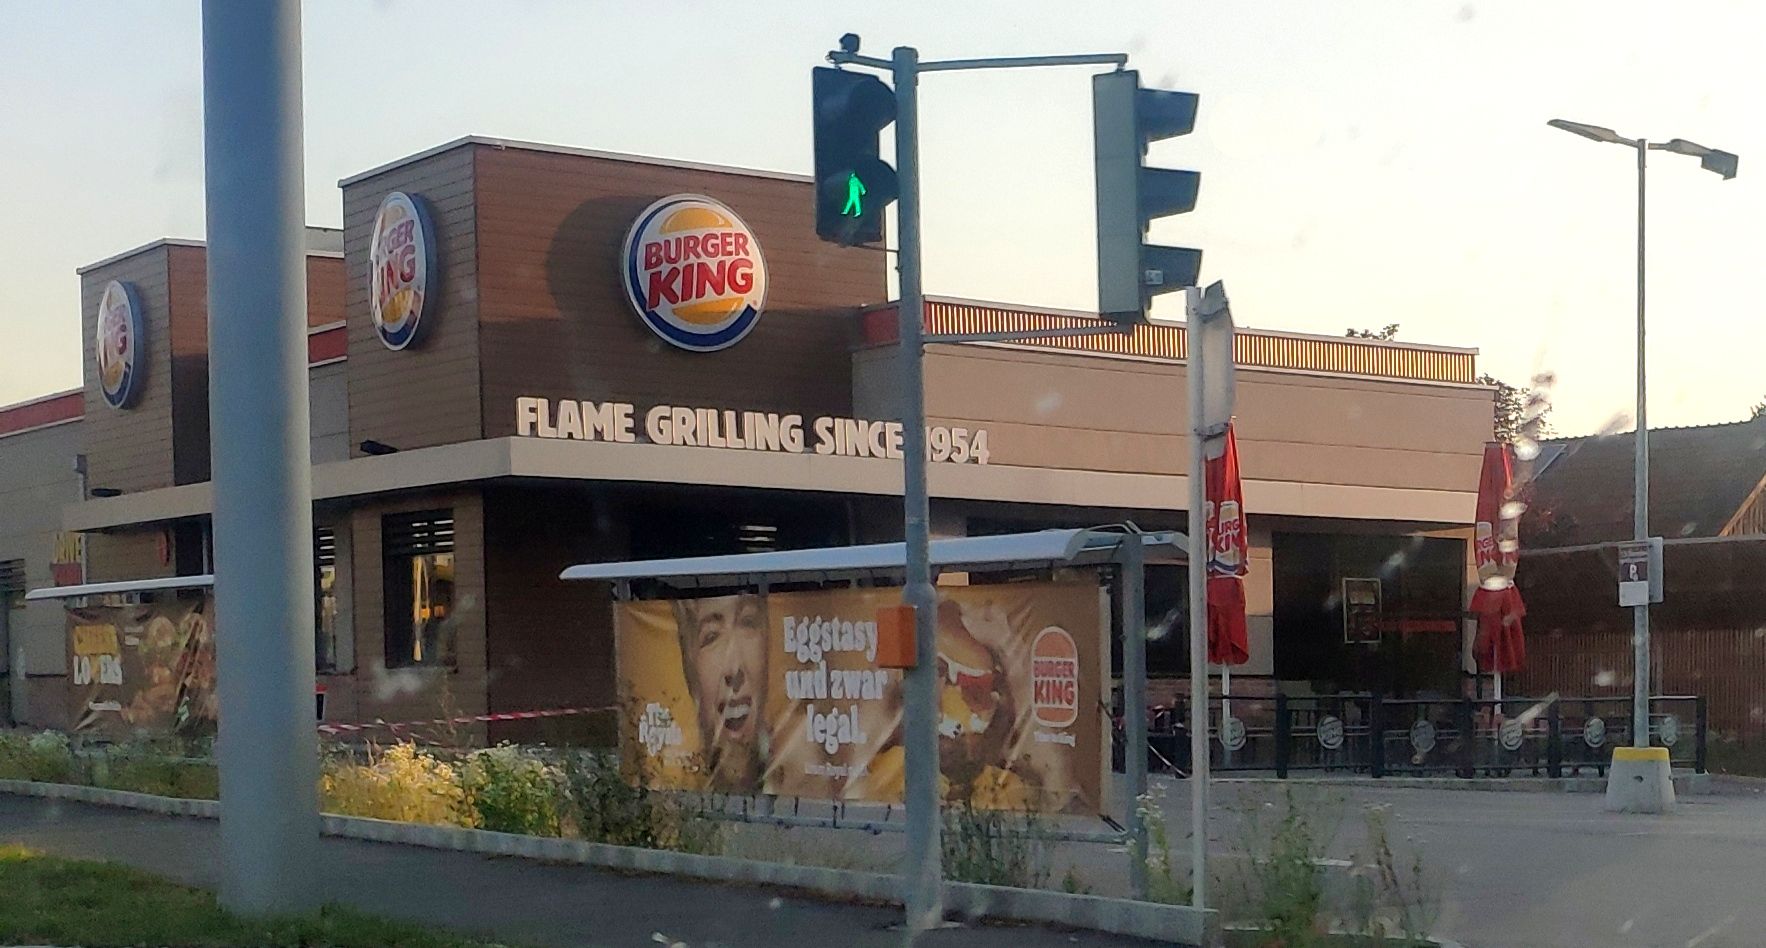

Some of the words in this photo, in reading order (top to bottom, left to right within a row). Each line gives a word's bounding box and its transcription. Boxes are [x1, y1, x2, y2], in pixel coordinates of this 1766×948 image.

[644, 232, 749, 271] BURGER
[647, 259, 755, 310] KING
[516, 397, 634, 442] FLAME
[646, 405, 804, 453] GRILLING
[814, 417, 904, 460] SINCE
[924, 425, 989, 465] 1954
[784, 616, 878, 663] Eggstasy
[786, 660, 828, 699] und
[830, 670, 888, 699] zwar
[1034, 660, 1074, 678] BURGER
[1034, 680, 1074, 705] KING
